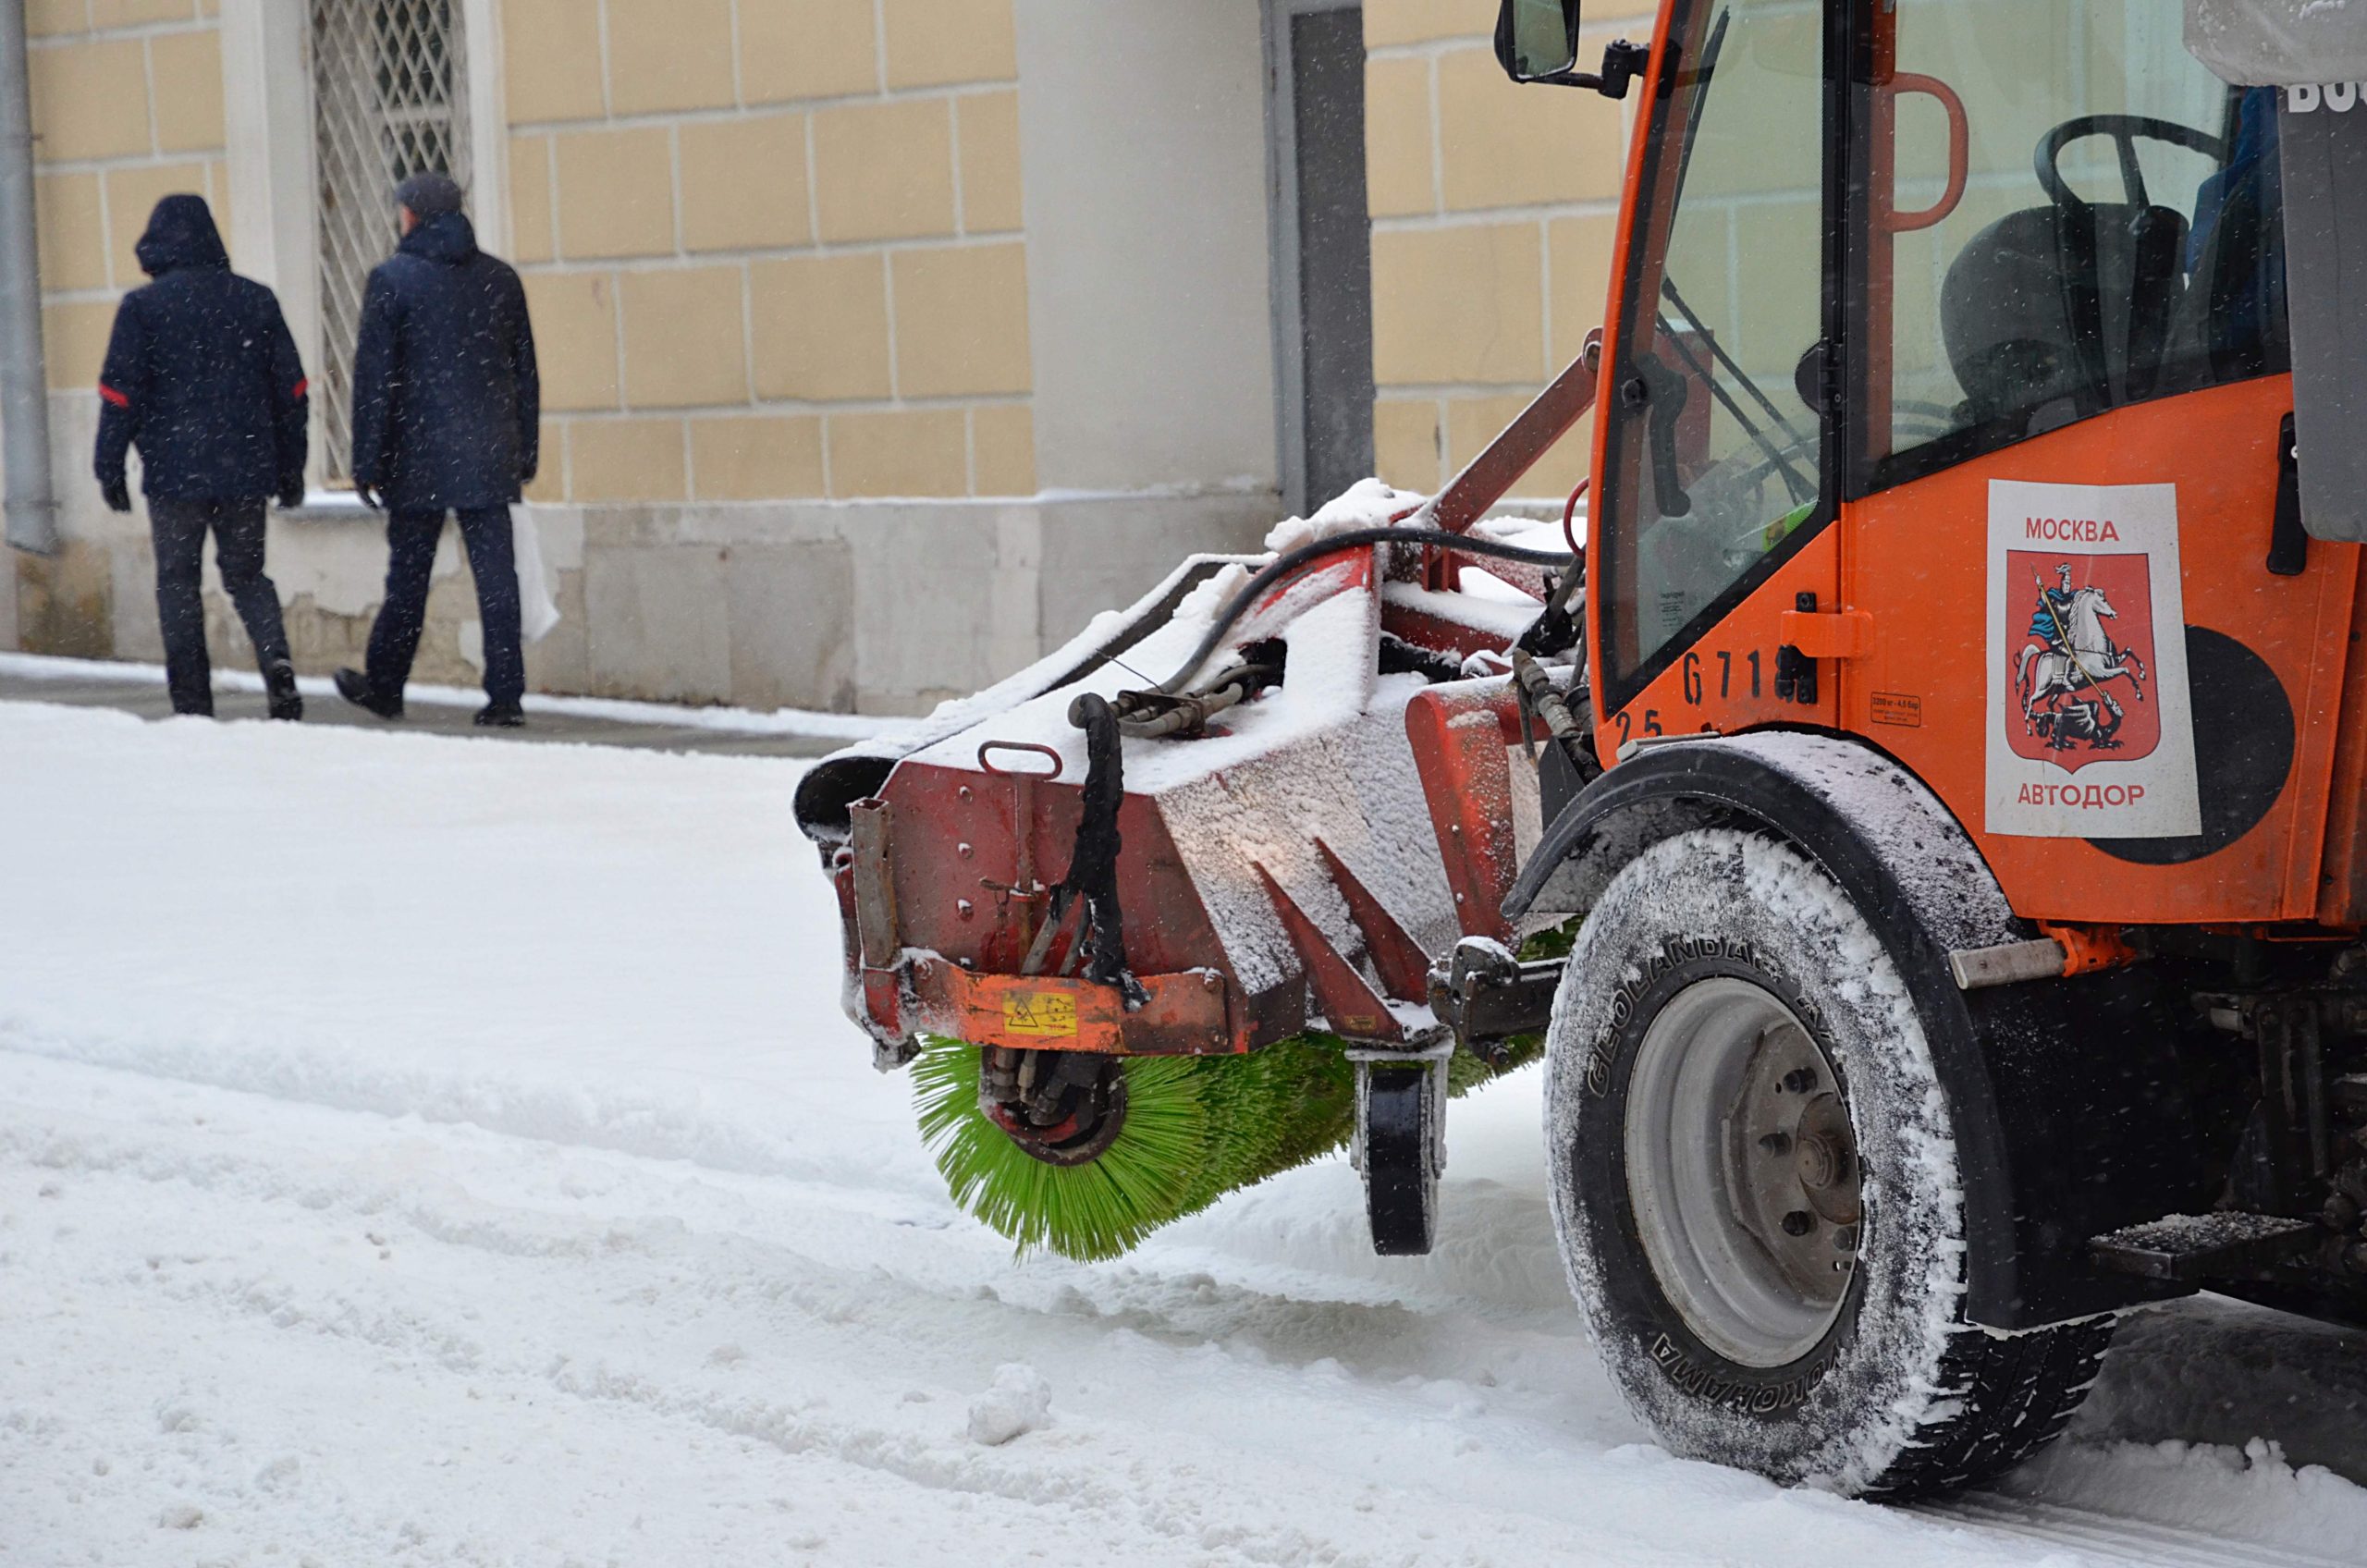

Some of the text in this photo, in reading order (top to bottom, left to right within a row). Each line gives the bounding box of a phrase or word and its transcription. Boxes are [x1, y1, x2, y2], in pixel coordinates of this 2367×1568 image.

[2287, 82, 2367, 113] BO
[2025, 517, 2120, 542] МОСКВА
[2017, 783, 2145, 809] АВТОДОР
